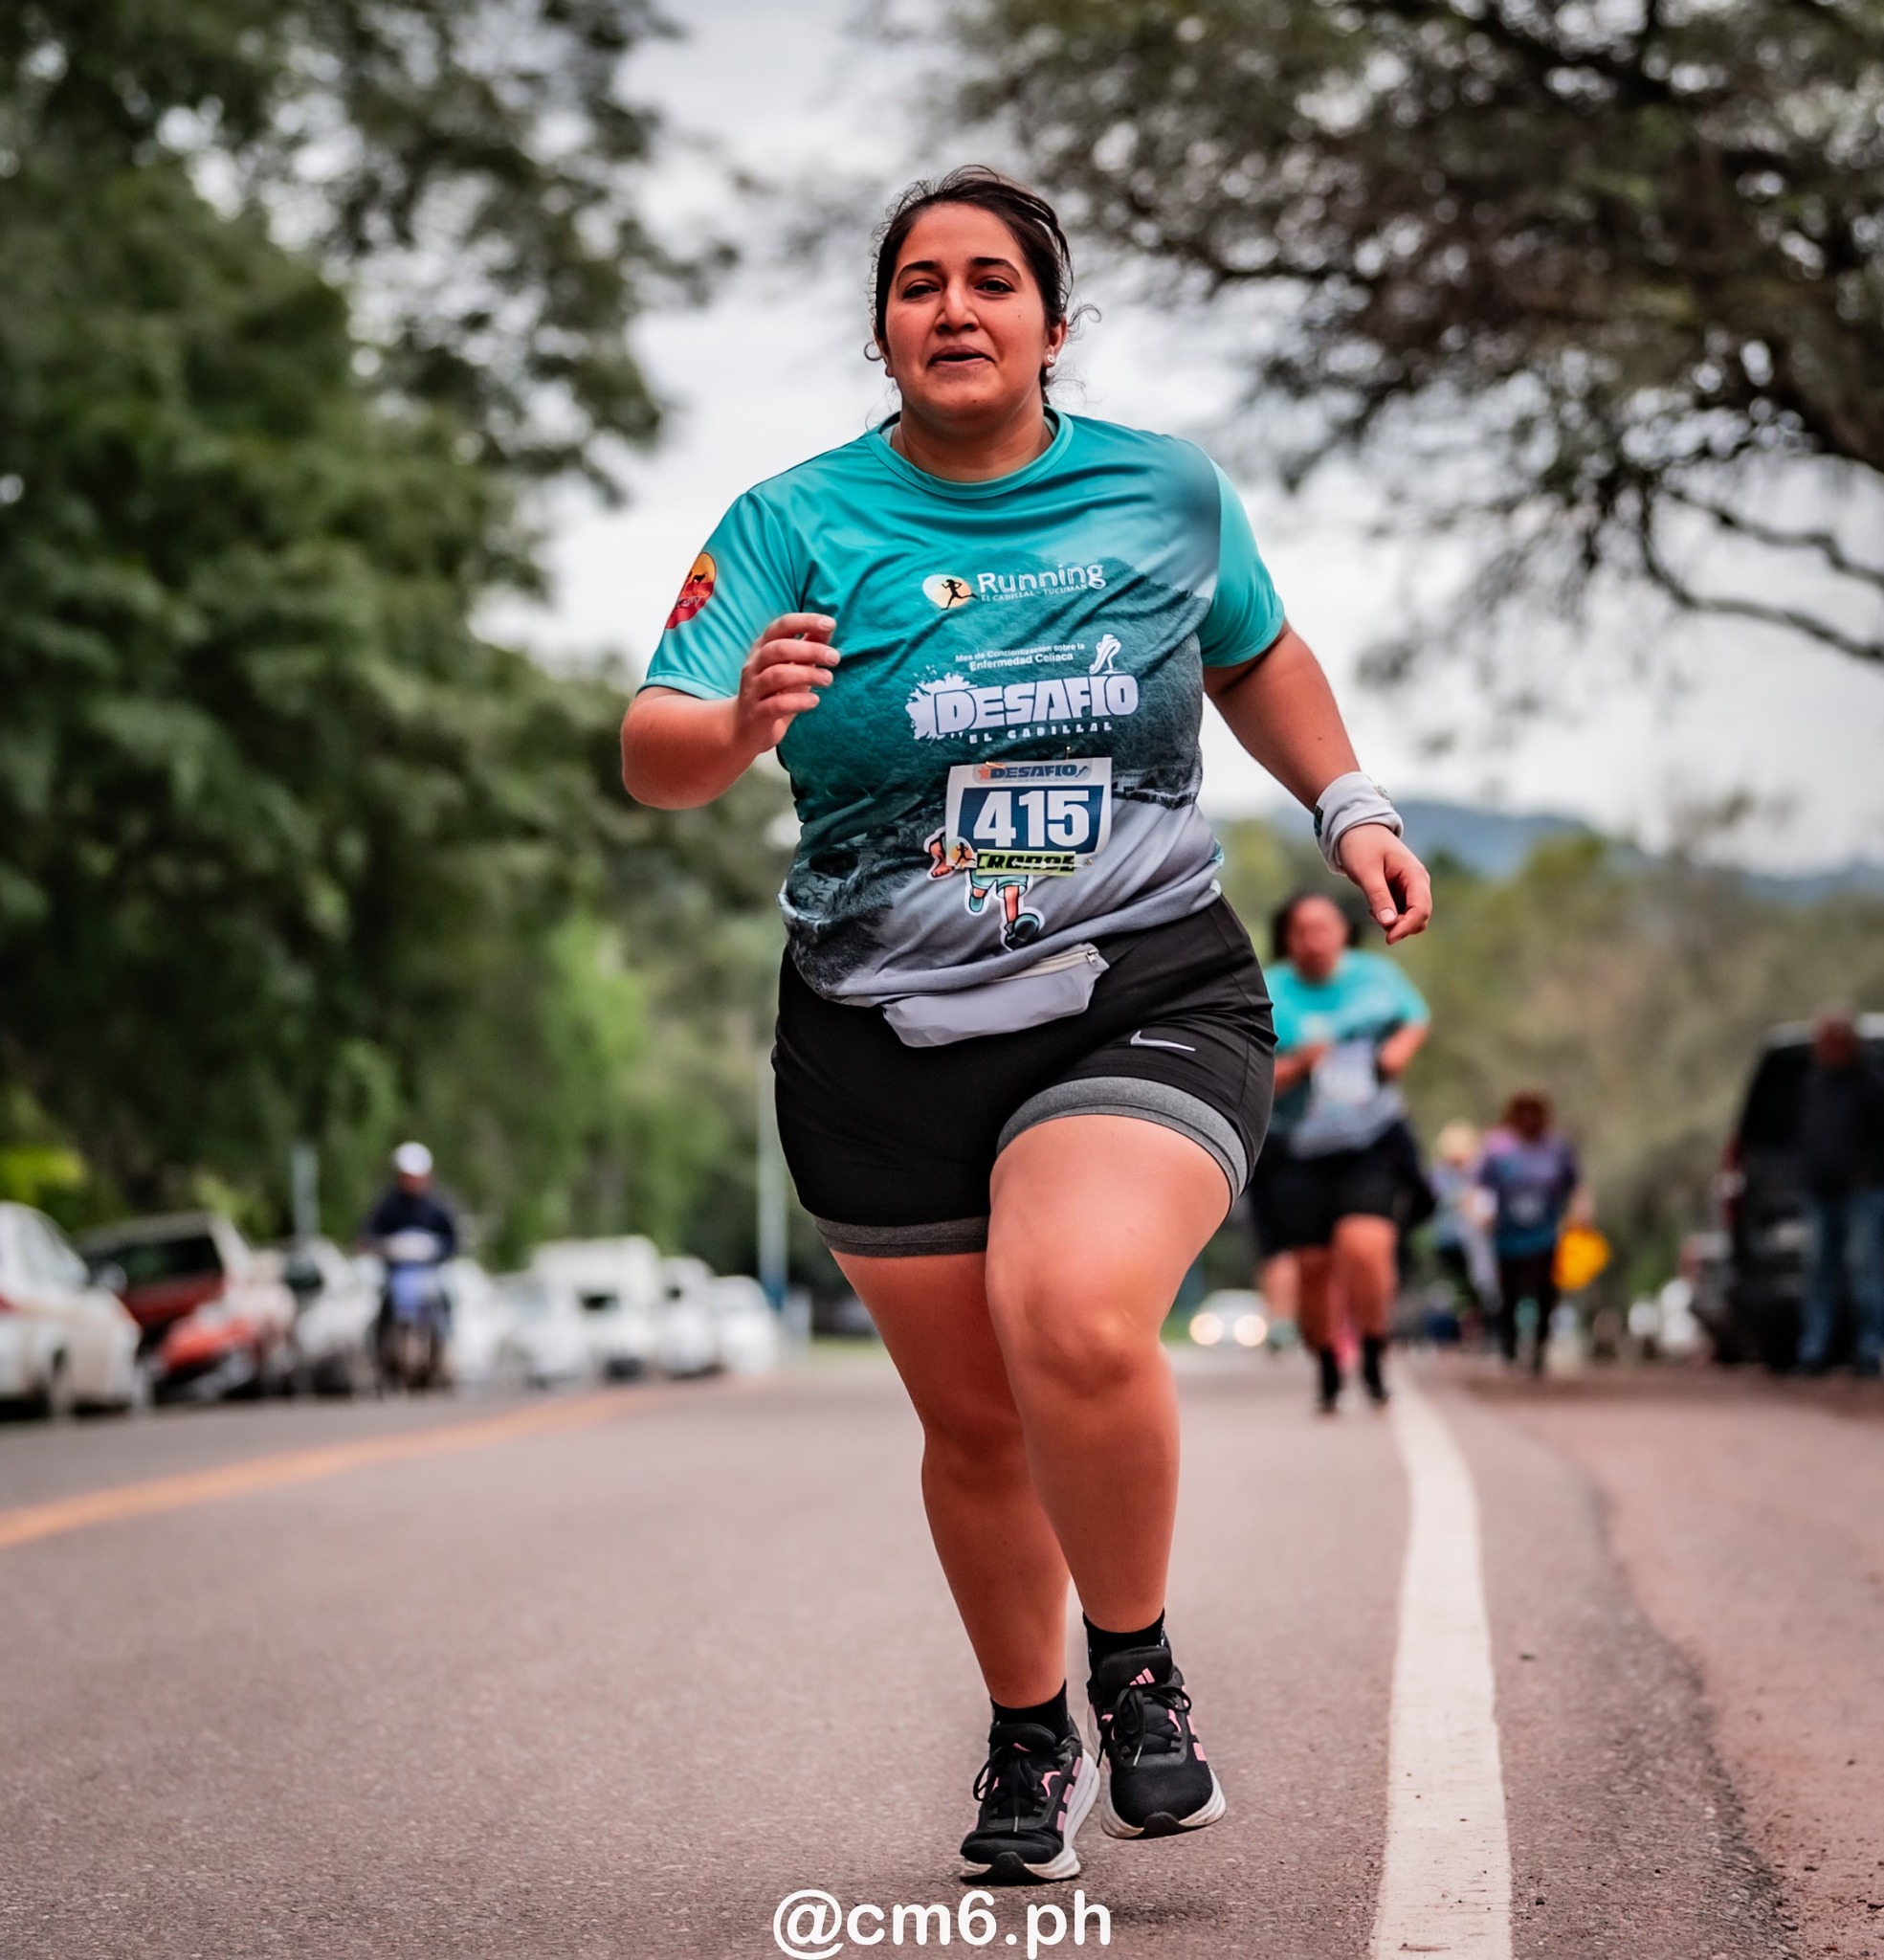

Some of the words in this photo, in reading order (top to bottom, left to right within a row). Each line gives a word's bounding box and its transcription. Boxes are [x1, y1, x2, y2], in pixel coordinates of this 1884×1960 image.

[977, 565, 1106, 593] Running
[955, 654, 973, 662] Mes
[974, 652, 986, 660] de
[1053, 643, 1075, 652] sobre
[1077, 642, 1086, 651] la
[969, 656, 1032, 671] Enfermedad
[968, 732, 993, 745] EL
[1007, 722, 1113, 740] CADILLAL
[972, 790, 1090, 848] 415
